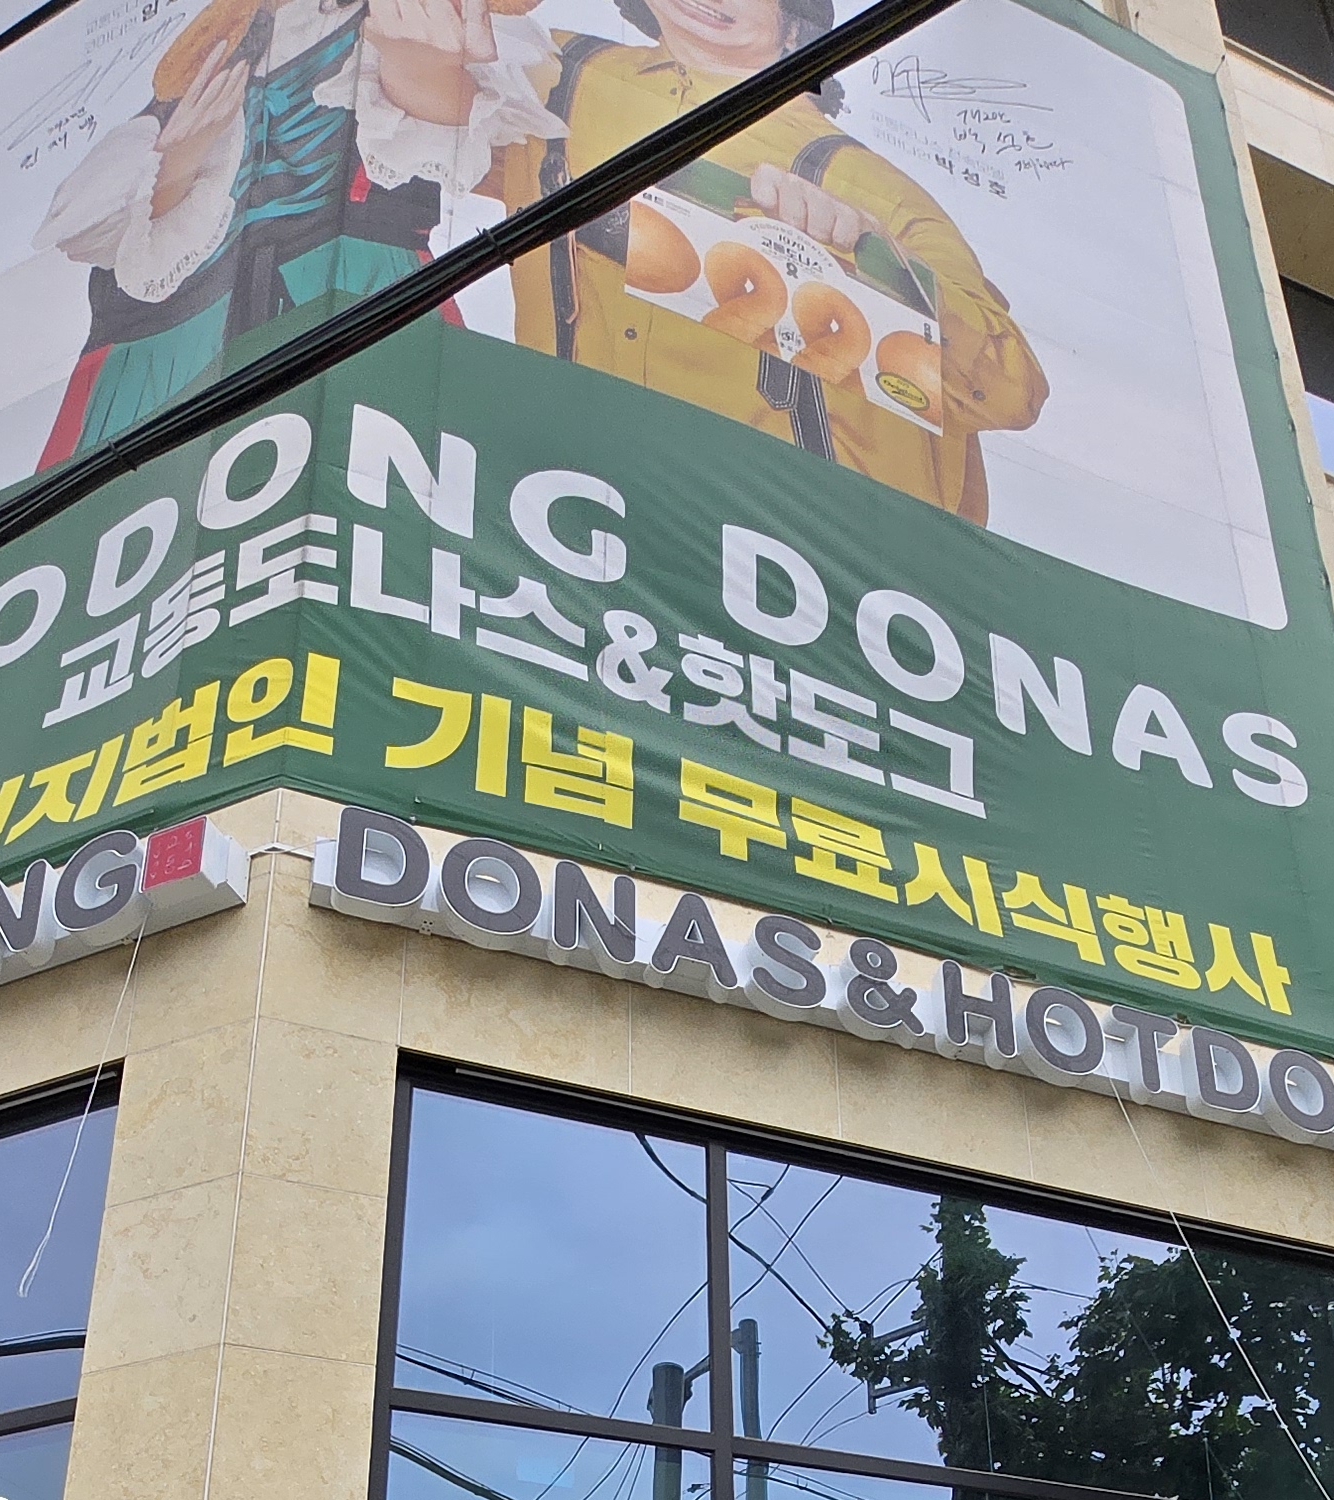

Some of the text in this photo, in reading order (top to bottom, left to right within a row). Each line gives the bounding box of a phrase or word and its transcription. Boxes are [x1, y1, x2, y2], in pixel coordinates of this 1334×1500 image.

[42, 513, 987, 819] 교동도나스&핫도그
[722, 523, 1310, 809] DONAS
[385, 677, 634, 830] 기념
[678, 757, 1292, 1017] 무료시식행사
